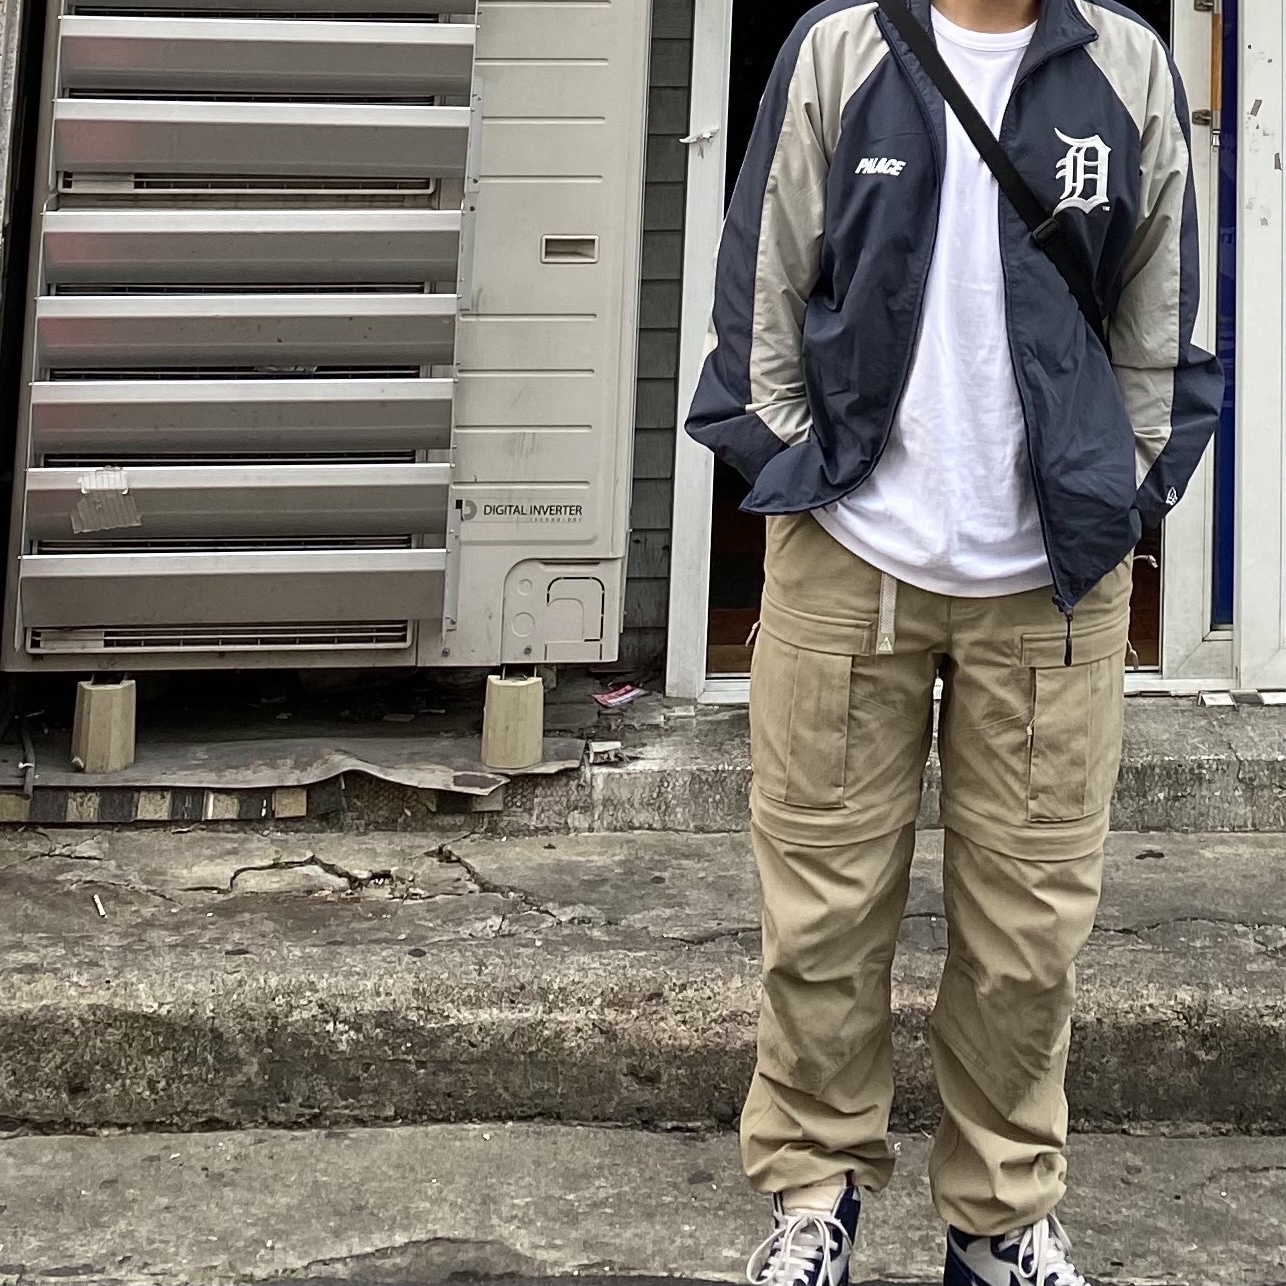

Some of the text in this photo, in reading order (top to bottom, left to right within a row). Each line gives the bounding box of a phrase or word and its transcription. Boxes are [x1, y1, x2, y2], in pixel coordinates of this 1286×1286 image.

[854, 157, 907, 177] PALACE
[1053, 127, 1112, 214] D
[483, 504, 583, 516] DIGITAL INVERTER
